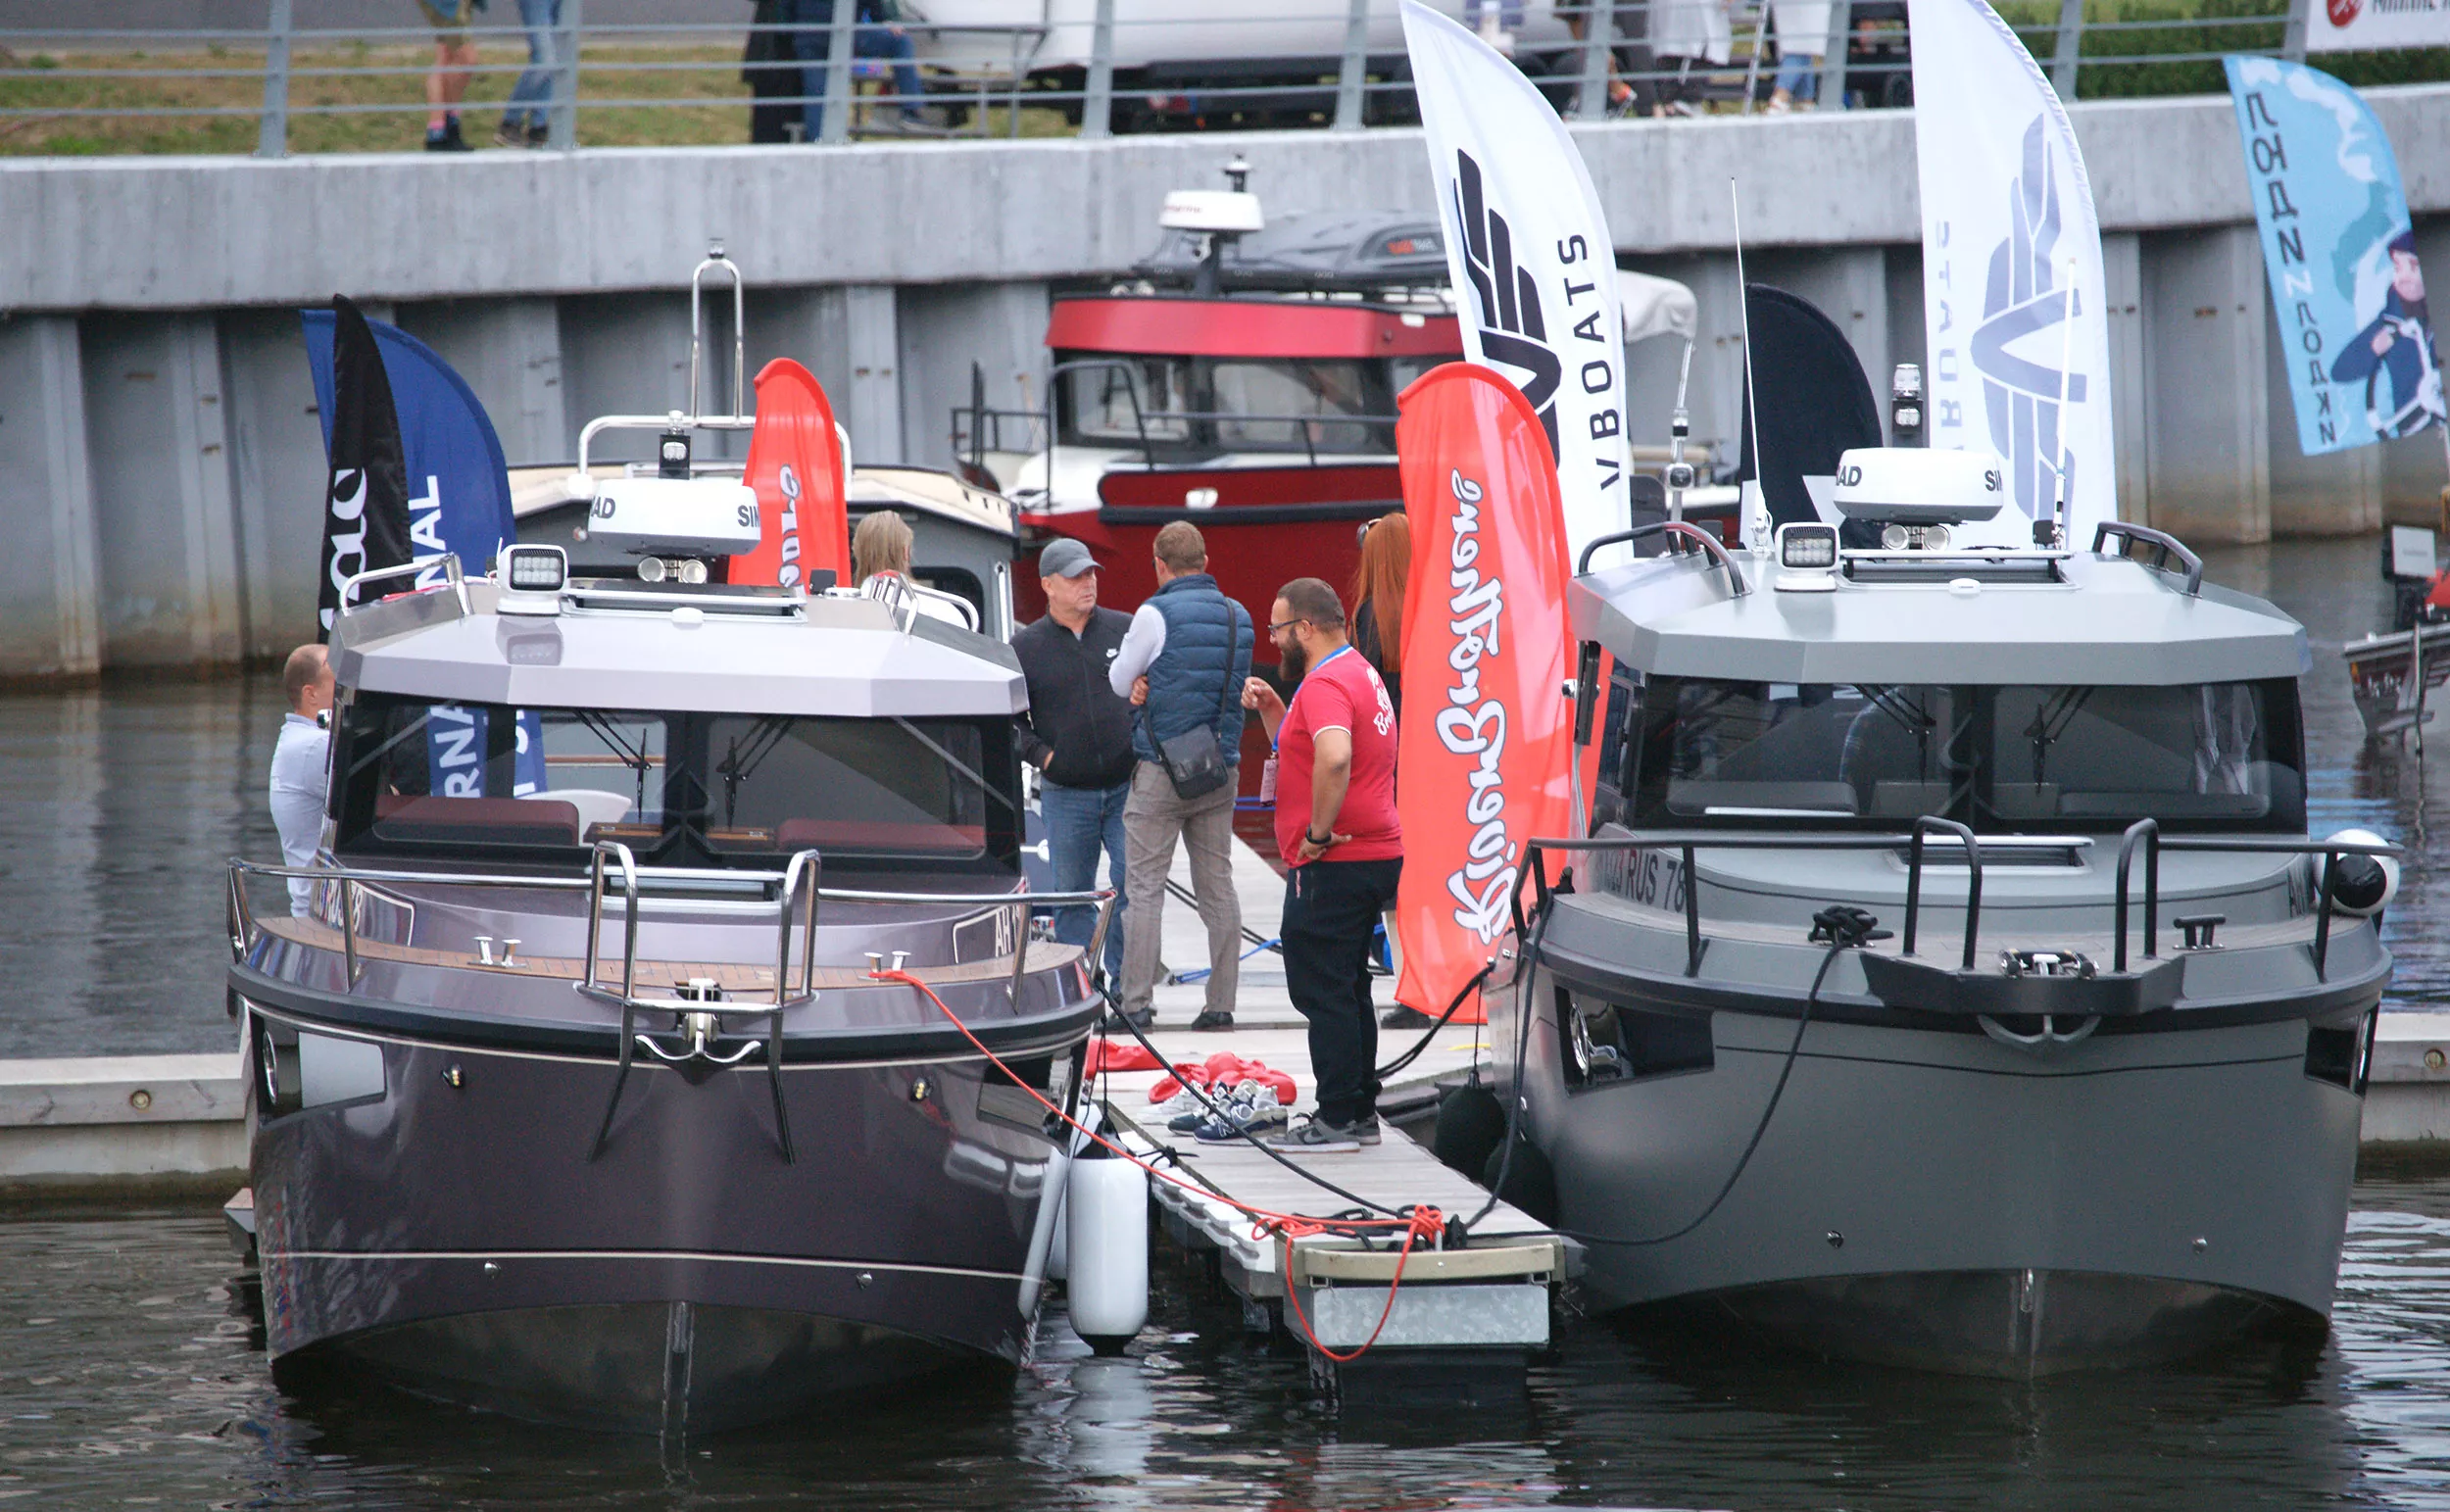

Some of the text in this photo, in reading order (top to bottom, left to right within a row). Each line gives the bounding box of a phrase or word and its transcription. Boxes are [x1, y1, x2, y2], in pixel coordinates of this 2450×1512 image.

[1557, 234, 1620, 490] VBOATS
[1837, 465, 1862, 487] AD
[591, 496, 616, 519] AD
[1626, 849, 1658, 905] RUS
[1664, 860, 1686, 913] 78
